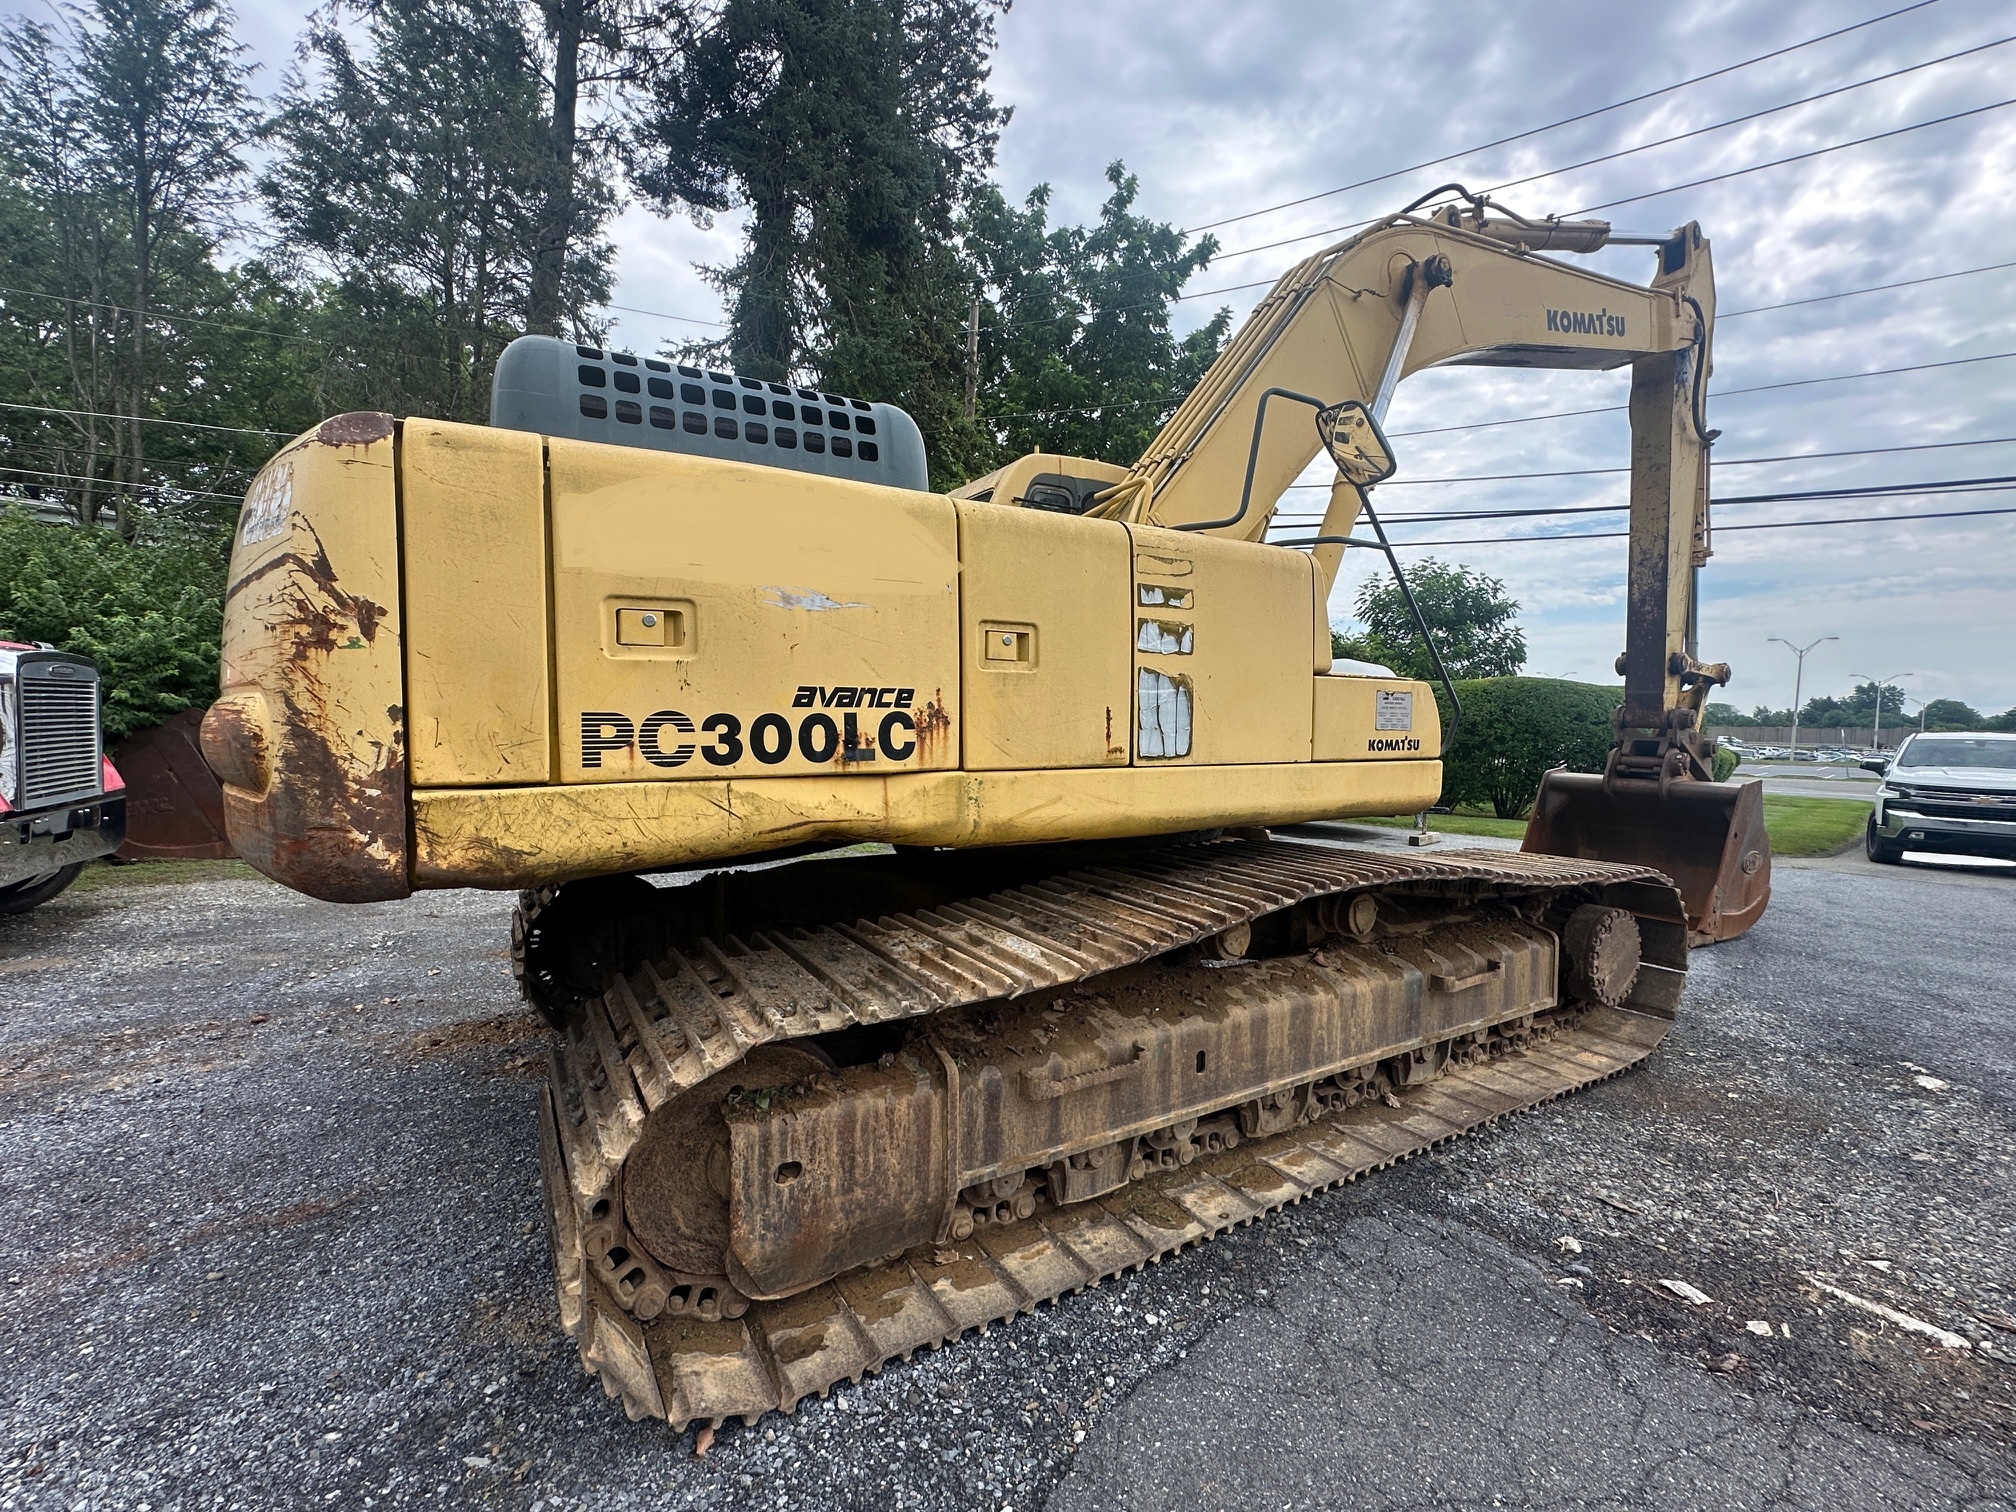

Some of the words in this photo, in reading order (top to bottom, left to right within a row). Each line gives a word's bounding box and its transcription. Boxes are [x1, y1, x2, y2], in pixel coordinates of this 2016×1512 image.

[1546, 308, 1626, 337] KOMATSU
[791, 685, 915, 708] avance
[581, 710, 916, 768] PC300LC
[1368, 736, 1420, 751] KOMATSU
